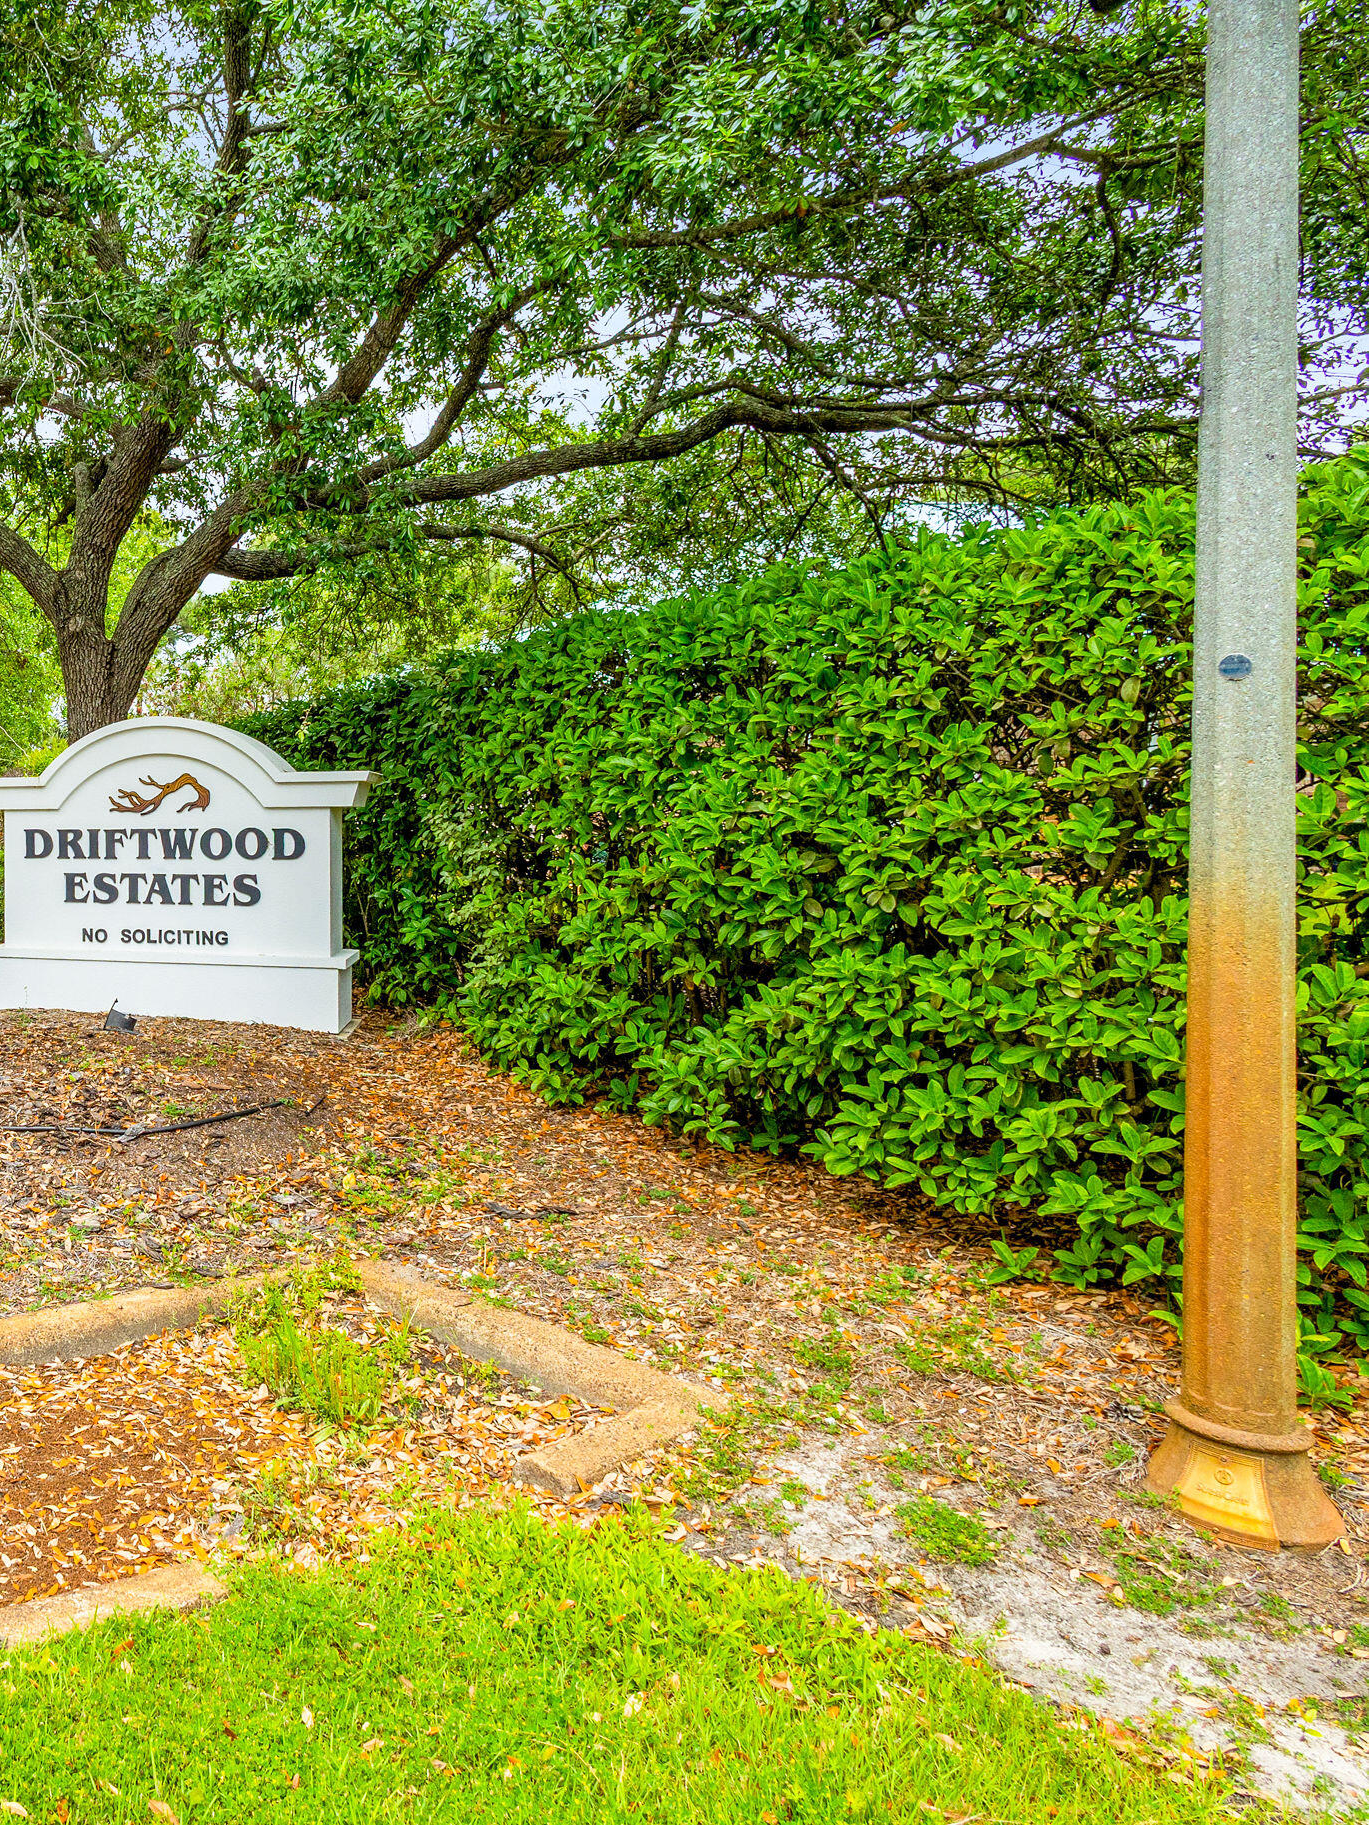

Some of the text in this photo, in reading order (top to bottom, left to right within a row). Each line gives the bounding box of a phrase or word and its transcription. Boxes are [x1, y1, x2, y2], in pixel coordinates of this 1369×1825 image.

[24, 828, 306, 860] DRIFTWOOD
[64, 873, 261, 906] ESTATES
[82, 928, 229, 945] NO SOLICITING
